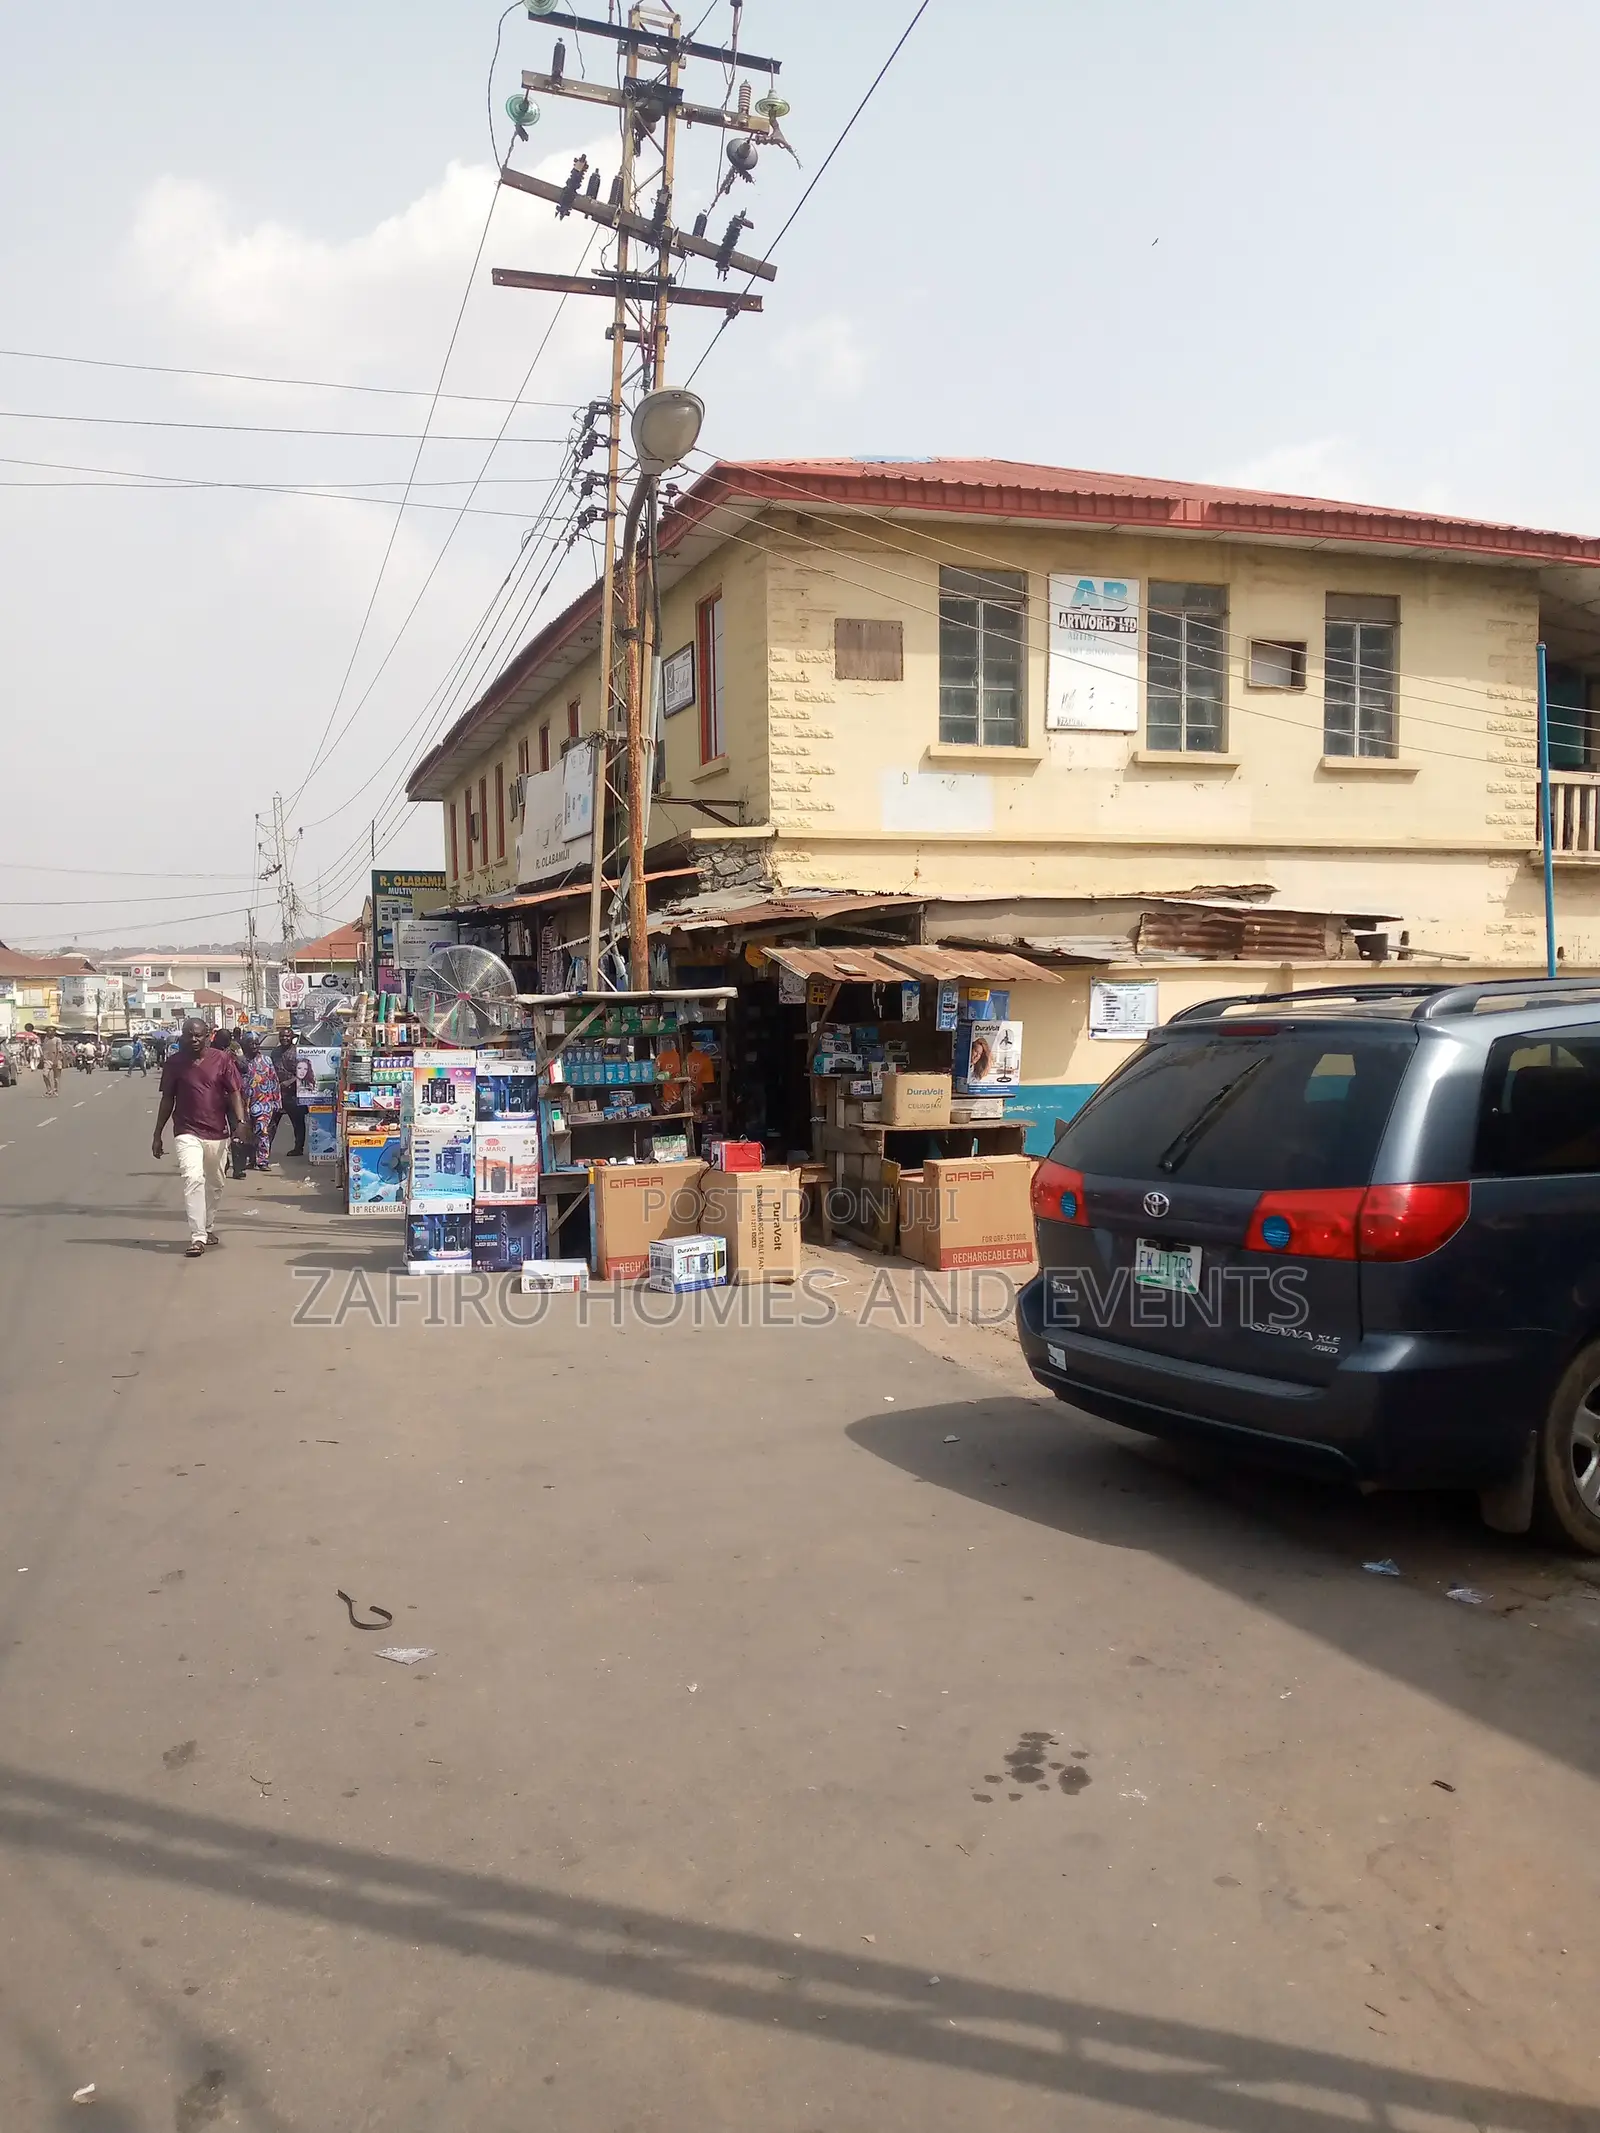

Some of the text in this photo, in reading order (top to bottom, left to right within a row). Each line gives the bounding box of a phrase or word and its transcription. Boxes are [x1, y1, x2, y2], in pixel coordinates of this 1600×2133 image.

[1069, 579, 1129, 612] AB
[1060, 613, 1137, 632] ARTWORLD LTD
[541, 849, 570, 867] OLABAMIJI
[379, 875, 391, 887] R.
[308, 974, 339, 988] LG
[974, 1024, 1000, 1032] DuraVolt
[906, 1087, 944, 1096] DuraVolt
[610, 1176, 664, 1189] QASA
[945, 1170, 995, 1182] QASA
[773, 1201, 782, 1251] DuraVolt
[677, 1246, 700, 1254] DuraVolt
[952, 1248, 1028, 1264] RECHARGEABLE FAN
[1250, 1321, 1341, 1345] SIENNA XLE
[1311, 1344, 1339, 1354] AWD
